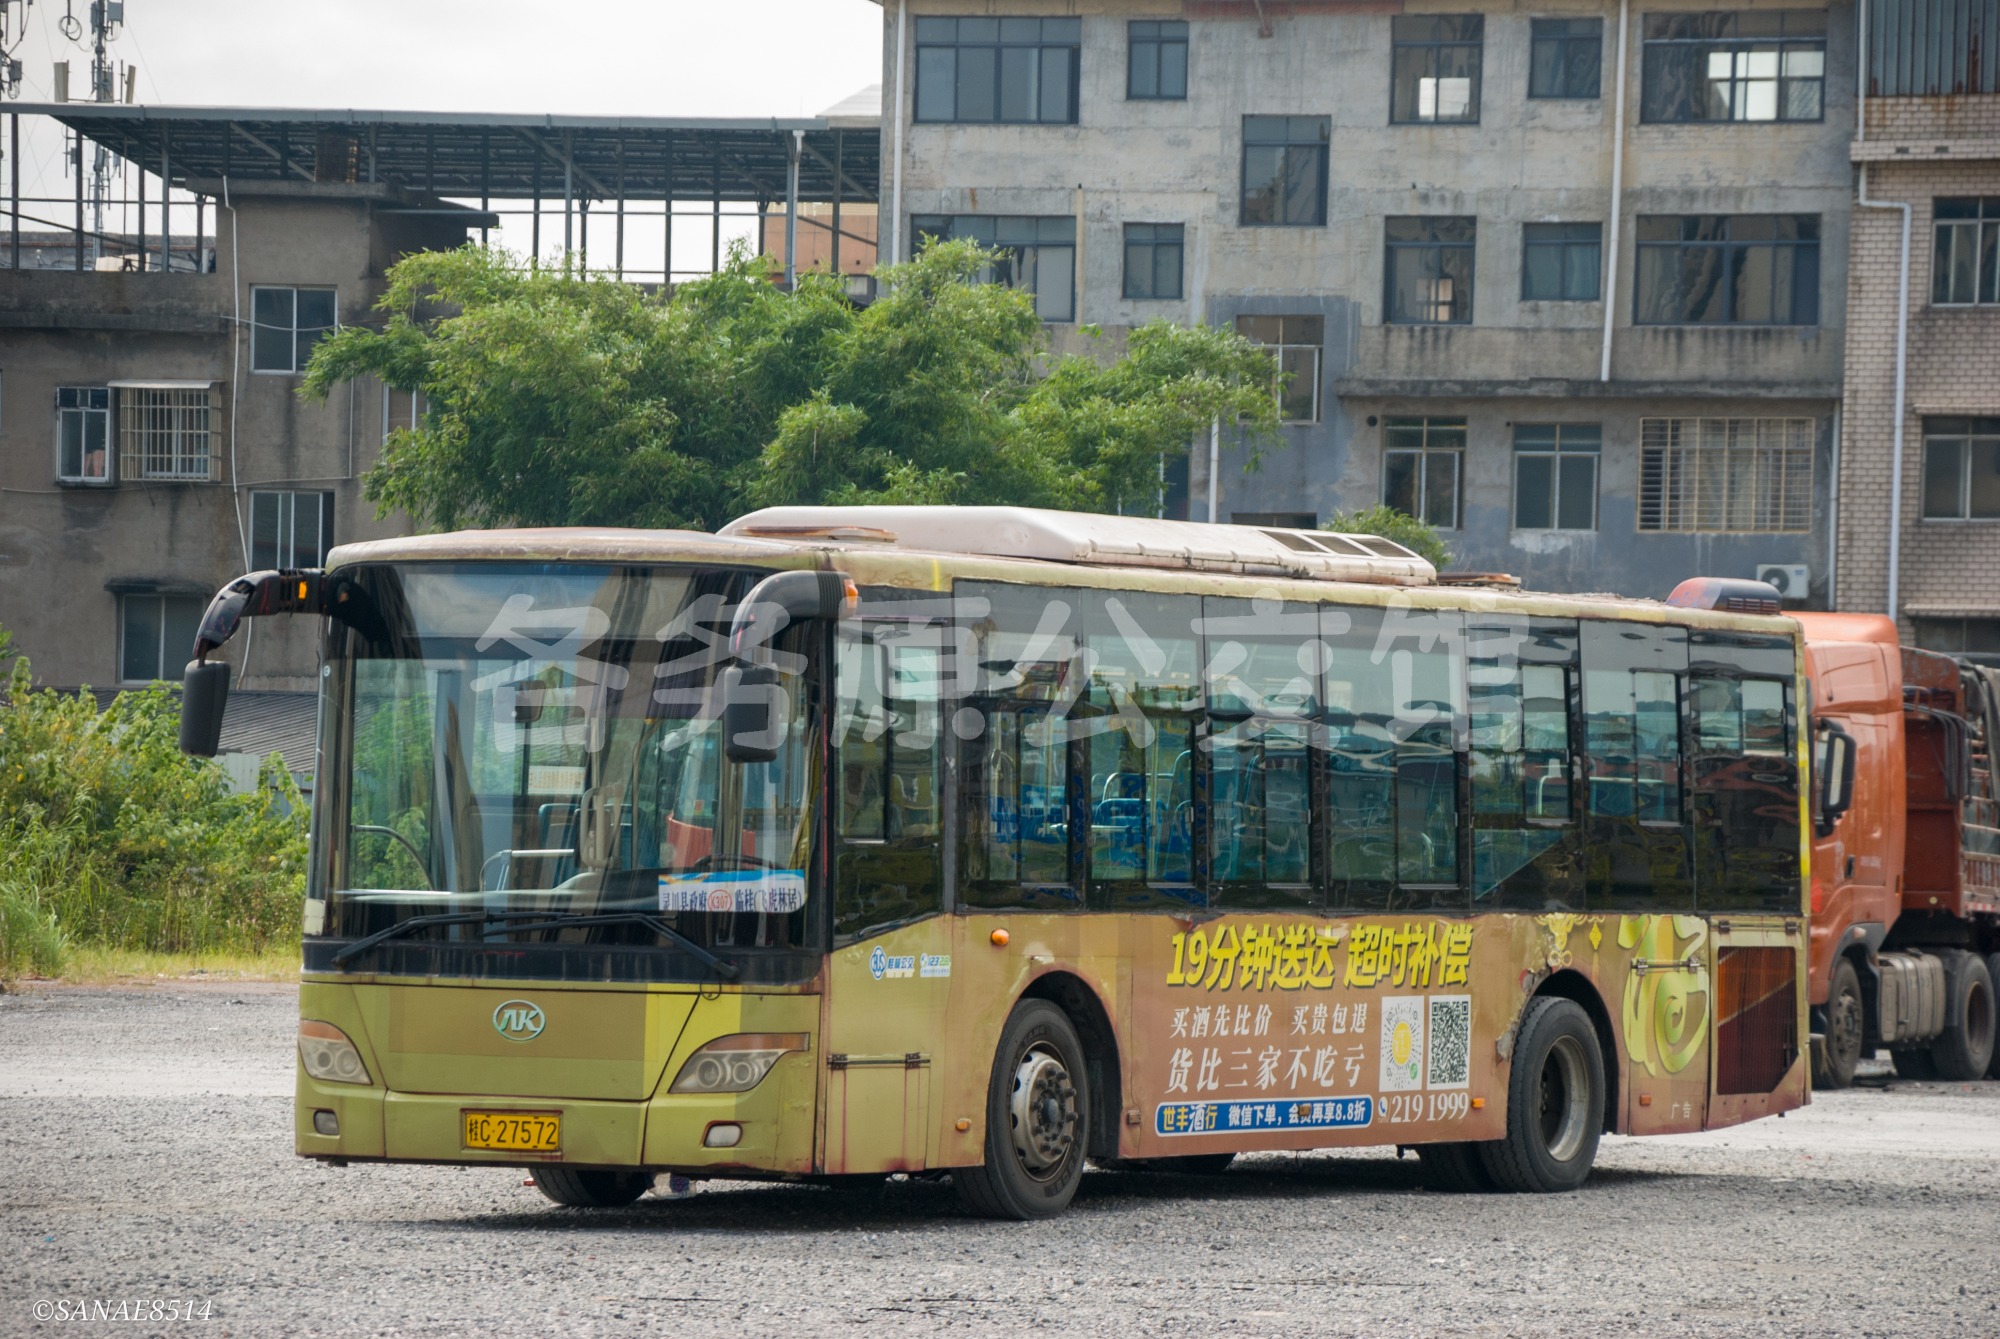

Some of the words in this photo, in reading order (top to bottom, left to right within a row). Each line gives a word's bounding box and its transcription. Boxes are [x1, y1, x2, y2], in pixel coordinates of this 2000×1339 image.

[1166, 922, 1342, 990] 19分钟送达
[1343, 922, 1474, 988] 超时补偿
[1169, 1004, 1273, 1039] 买酒先比价
[1290, 1002, 1368, 1036] 买贵包退
[1164, 1043, 1365, 1094] 货比三家不吃亏
[1163, 1103, 1218, 1133] 世丰酒行
[1391, 1094, 1423, 1123] 219
[1427, 1092, 1469, 1121] 1999
[1670, 1101, 1692, 1120] 广告
